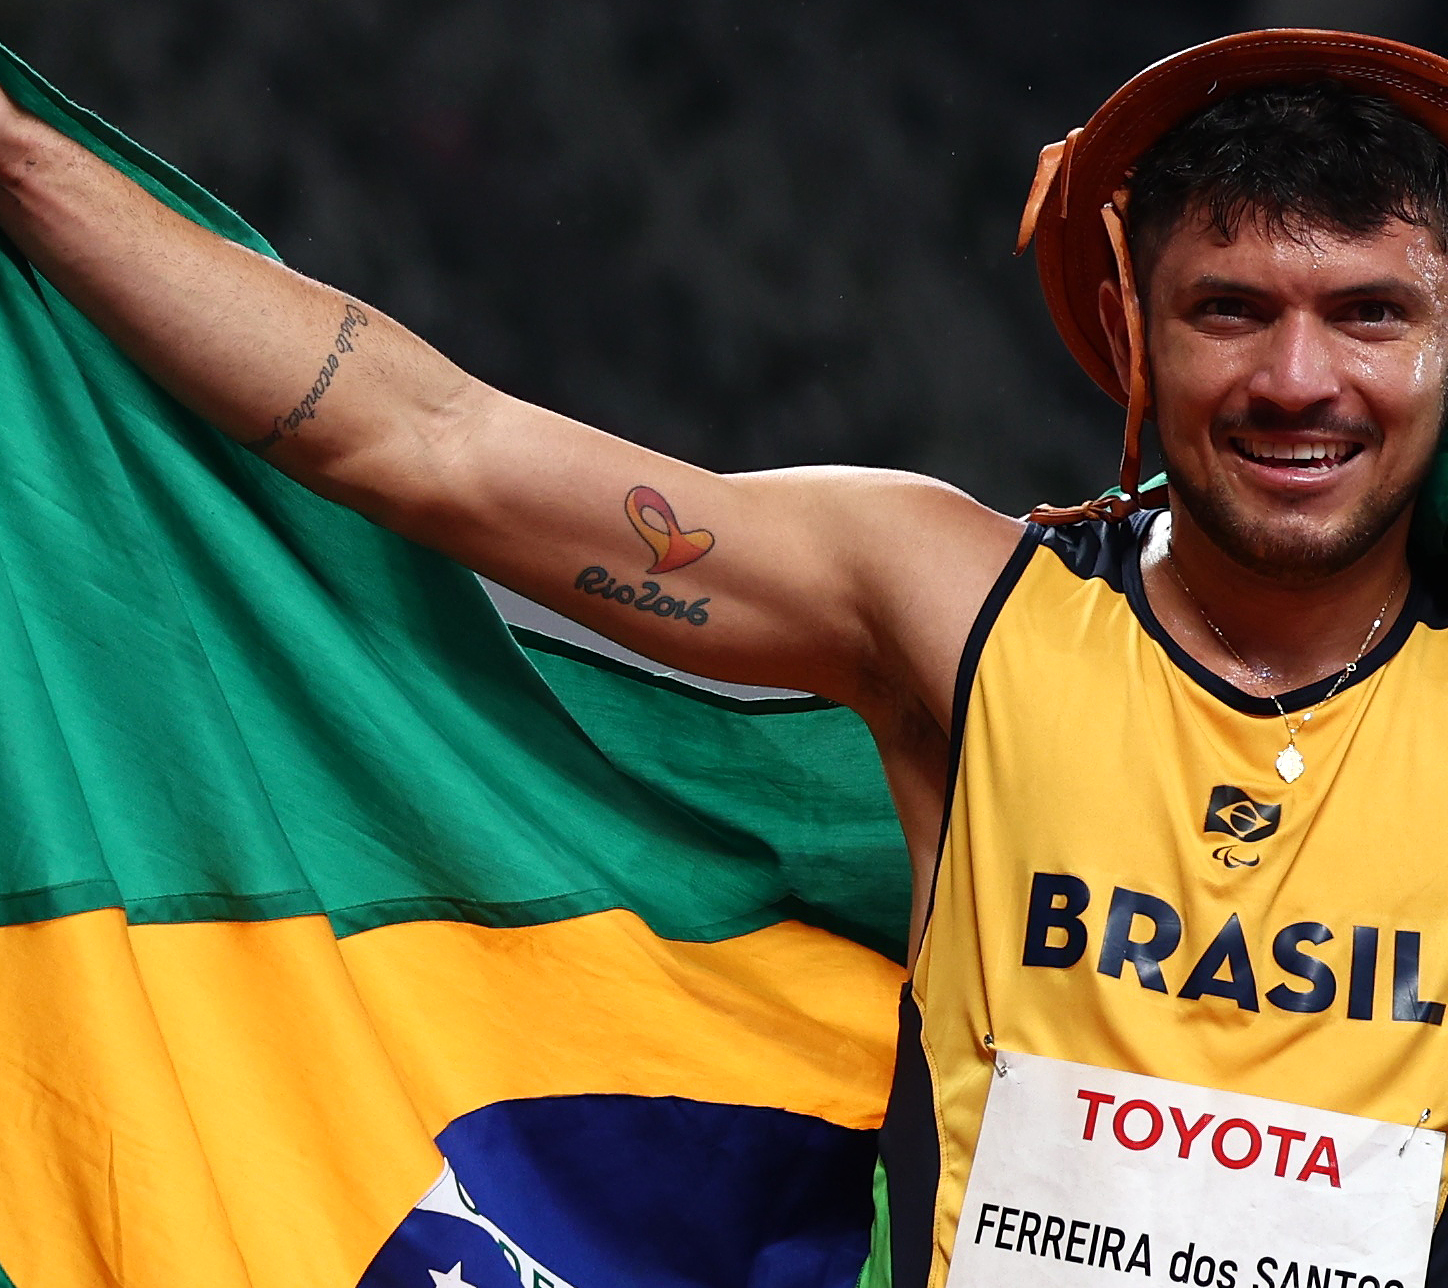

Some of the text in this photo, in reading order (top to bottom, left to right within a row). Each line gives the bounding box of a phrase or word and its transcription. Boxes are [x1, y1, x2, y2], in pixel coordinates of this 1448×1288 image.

[1022, 871, 1447, 1027] BRASIL
[1077, 1089, 1342, 1189] TOYOTA
[974, 1202, 1152, 1277] FERREIRA
